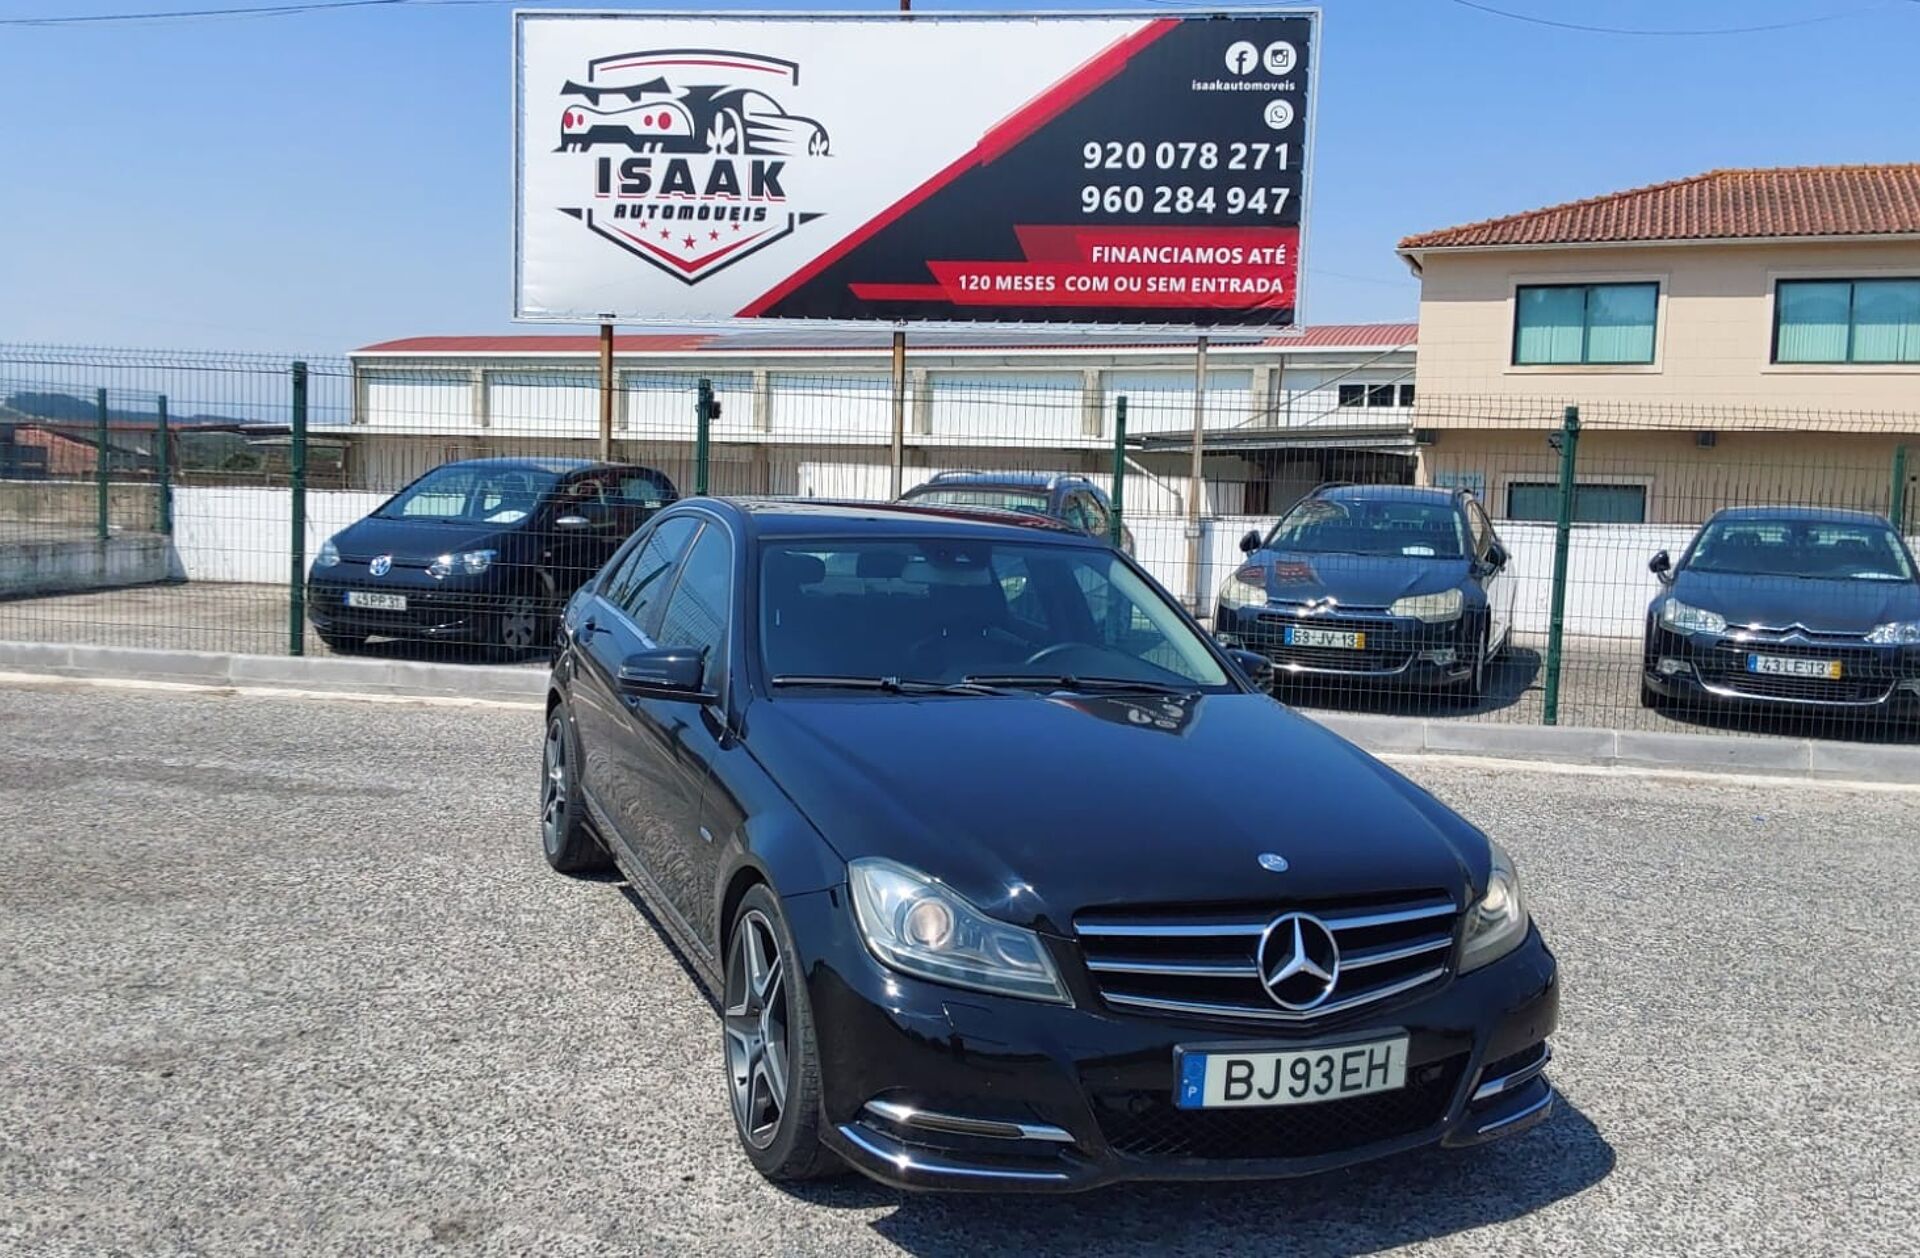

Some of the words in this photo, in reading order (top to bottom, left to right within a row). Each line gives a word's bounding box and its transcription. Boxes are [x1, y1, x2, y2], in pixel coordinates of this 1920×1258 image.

[1192, 80, 1296, 91] isaakautomoveis
[1083, 142, 1146, 169] 920
[1155, 142, 1218, 170] 078
[1228, 143, 1289, 170] 271
[595, 157, 786, 200] ISAAK
[1081, 186, 1144, 213] 960
[1153, 186, 1216, 213] 284
[1226, 187, 1290, 214] 947
[1092, 246, 1243, 264] FINANCIAMOS
[1248, 244, 1286, 265] ATÉ
[958, 275, 991, 290] 120
[996, 275, 1056, 290] MESES
[1065, 276, 1109, 291] COM
[1114, 277, 1142, 292] OU
[1147, 277, 1186, 292] SEM
[1191, 278, 1284, 293] ENTRADA
[1224, 1046, 1391, 1101] BJ93EH
